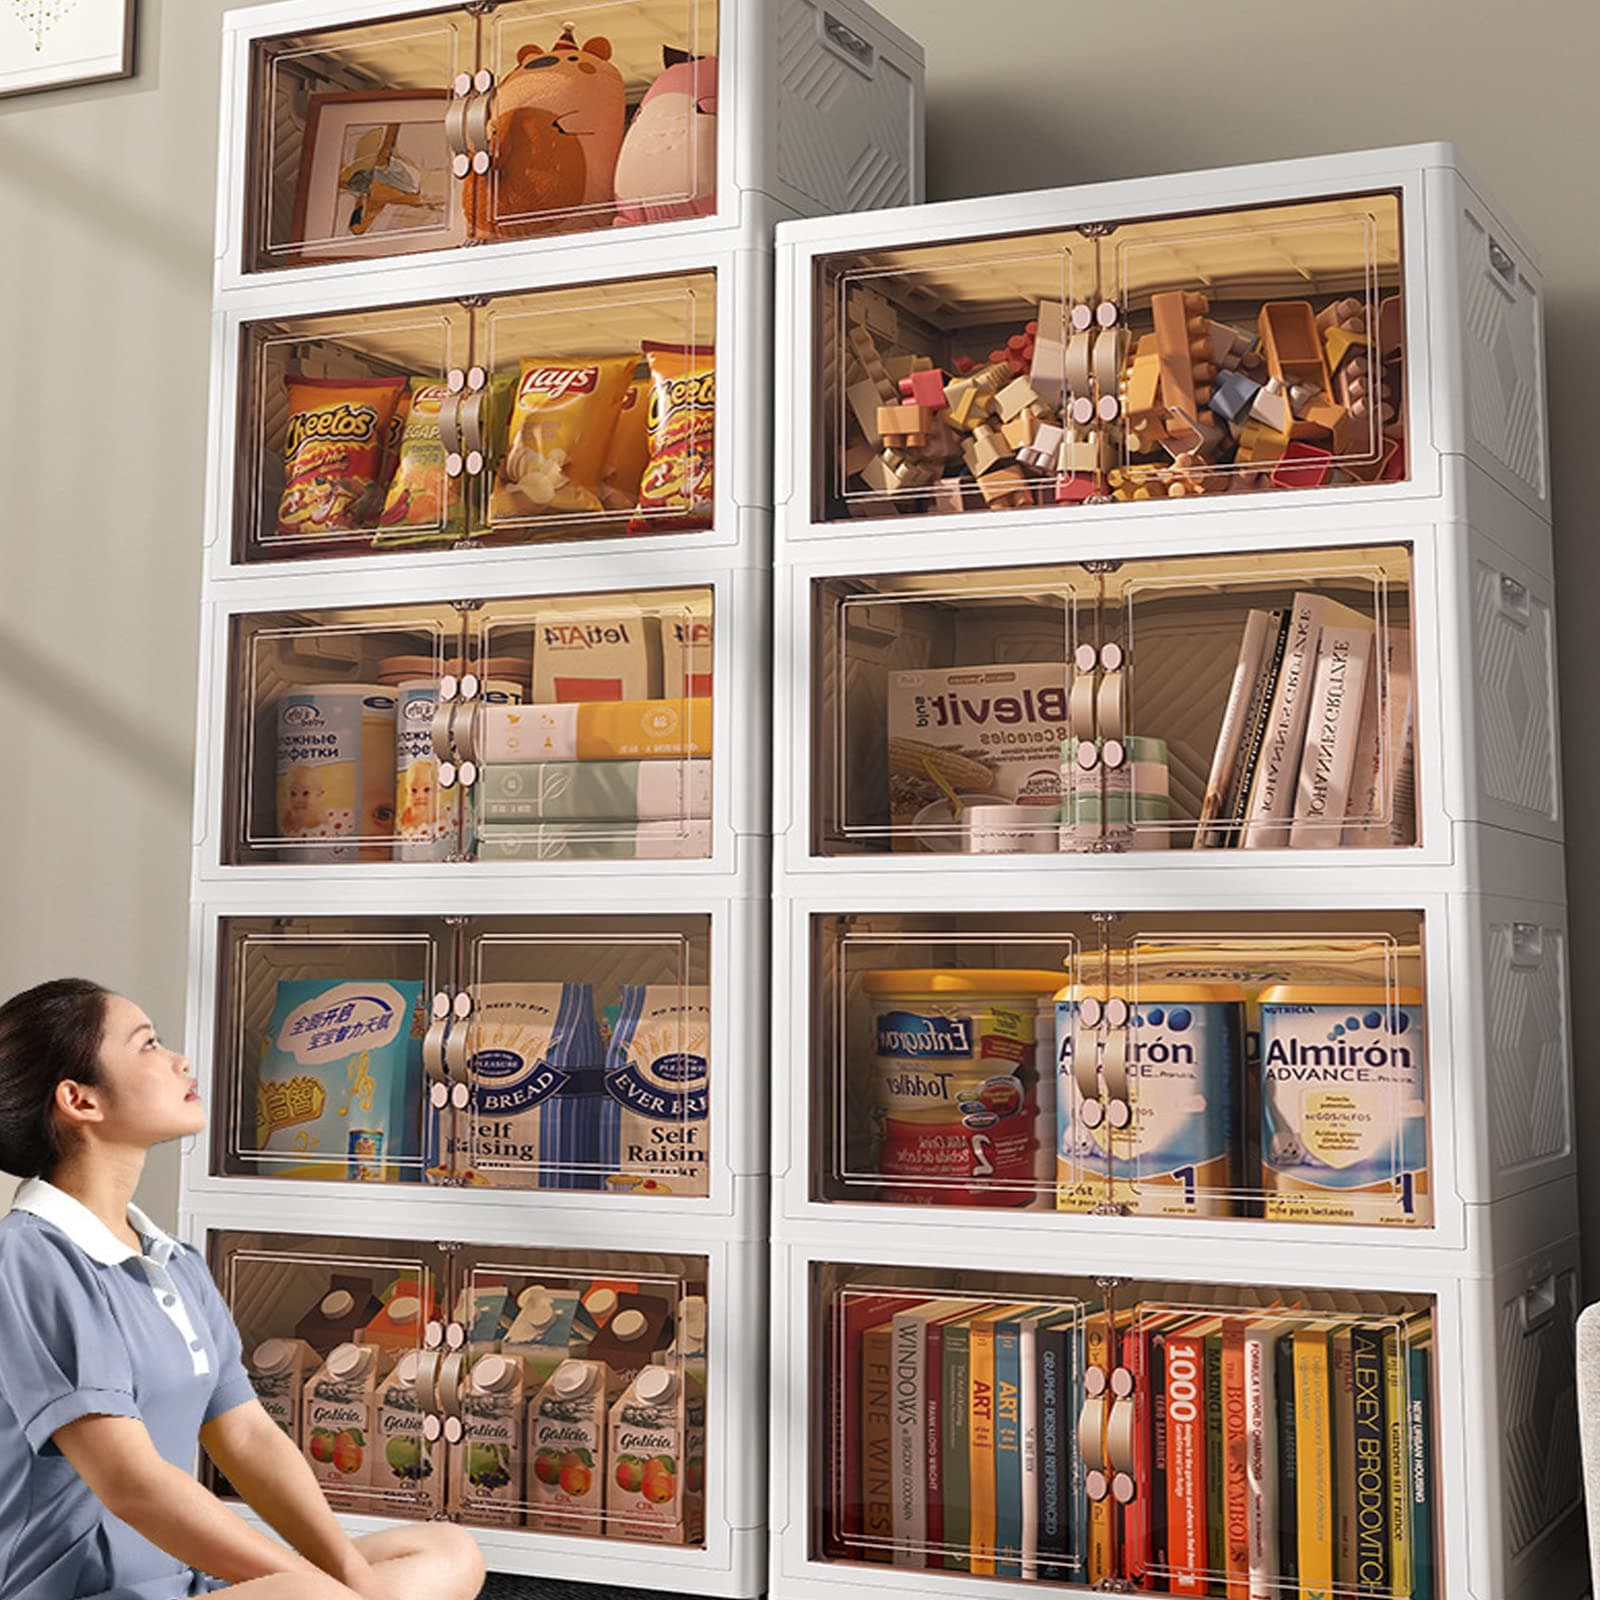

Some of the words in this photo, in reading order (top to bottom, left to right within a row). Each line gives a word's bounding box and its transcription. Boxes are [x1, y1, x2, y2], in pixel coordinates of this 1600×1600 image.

[285, 733, 337, 746] ажные
[288, 747, 339, 762] фетки
[1266, 1038, 1410, 1068] Almirón
[485, 1071, 555, 1110] BREAD
[614, 1073, 665, 1114] EVER
[1266, 1068, 1370, 1082] ADVANCE
[627, 1145, 707, 1163] Raisin
[651, 1127, 698, 1145] Self
[896, 1323, 918, 1426] WINDOWS
[1043, 1351, 1056, 1404] GRAPHIC
[1169, 1345, 1197, 1422] 1000
[1208, 1348, 1222, 1412] MAKING
[1250, 1343, 1261, 1387] FORMULA
[1354, 1335, 1379, 1433] ALEXEY
[867, 1362, 889, 1425] FINE
[973, 1380, 991, 1420] ART
[998, 1381, 1017, 1423] ART
[1251, 1395, 1262, 1427] WORLD
[1412, 1400, 1423, 1423] NEW
[313, 1406, 363, 1423] Galicia
[1044, 1406, 1056, 1444] DESIGN
[1227, 1386, 1245, 1444] BOOK
[538, 1426, 592, 1444] Galicia
[619, 1433, 675, 1450] Galicia
[867, 1436, 890, 1530] WINES
[1228, 1463, 1247, 1563] SYMBOLS
[1357, 1438, 1384, 1594] BRODOVITCH
